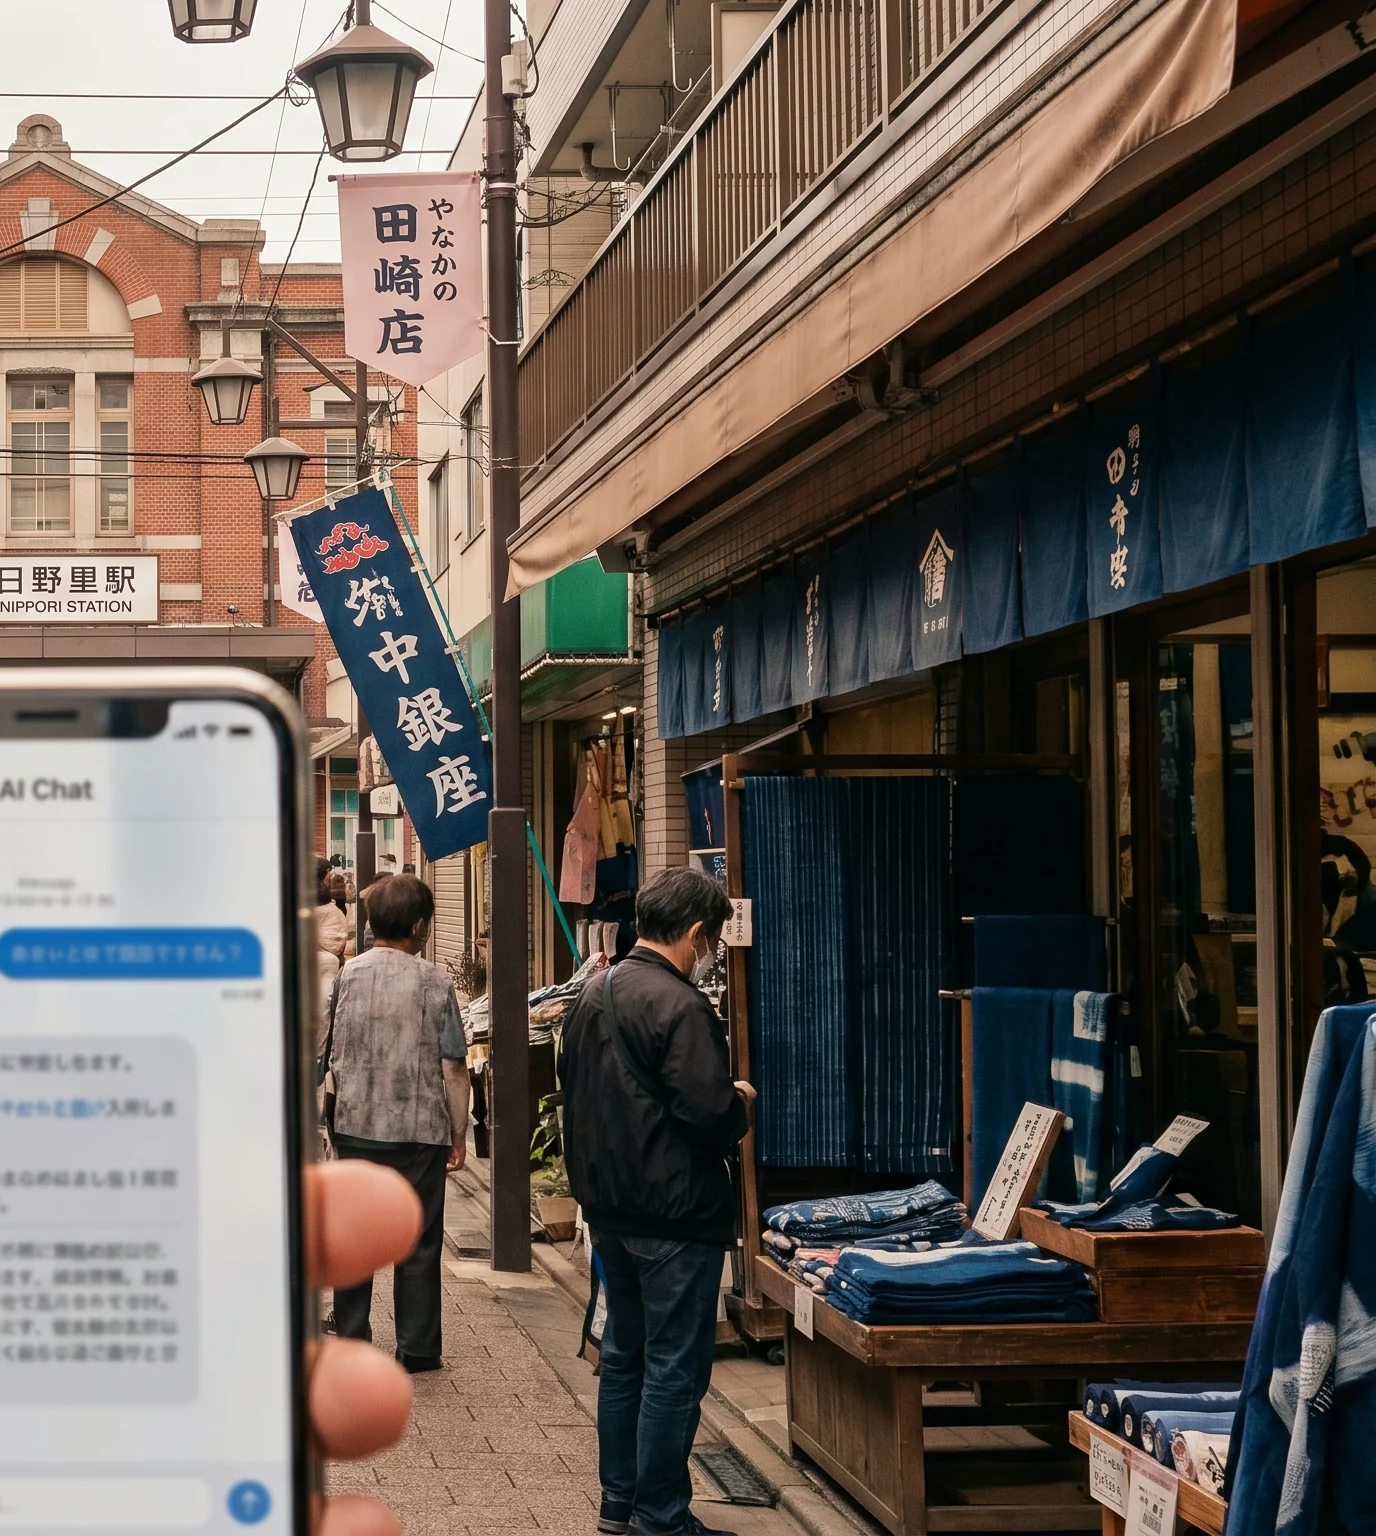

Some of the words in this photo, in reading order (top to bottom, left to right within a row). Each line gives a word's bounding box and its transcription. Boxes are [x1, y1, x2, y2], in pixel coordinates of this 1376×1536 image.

[372, 204, 424, 355] 田崎店
[428, 198, 457, 301] やなかの
[0, 600, 62, 613] NIPPORI
[67, 600, 132, 613] STATION
[32, 778, 93, 800] Chat
